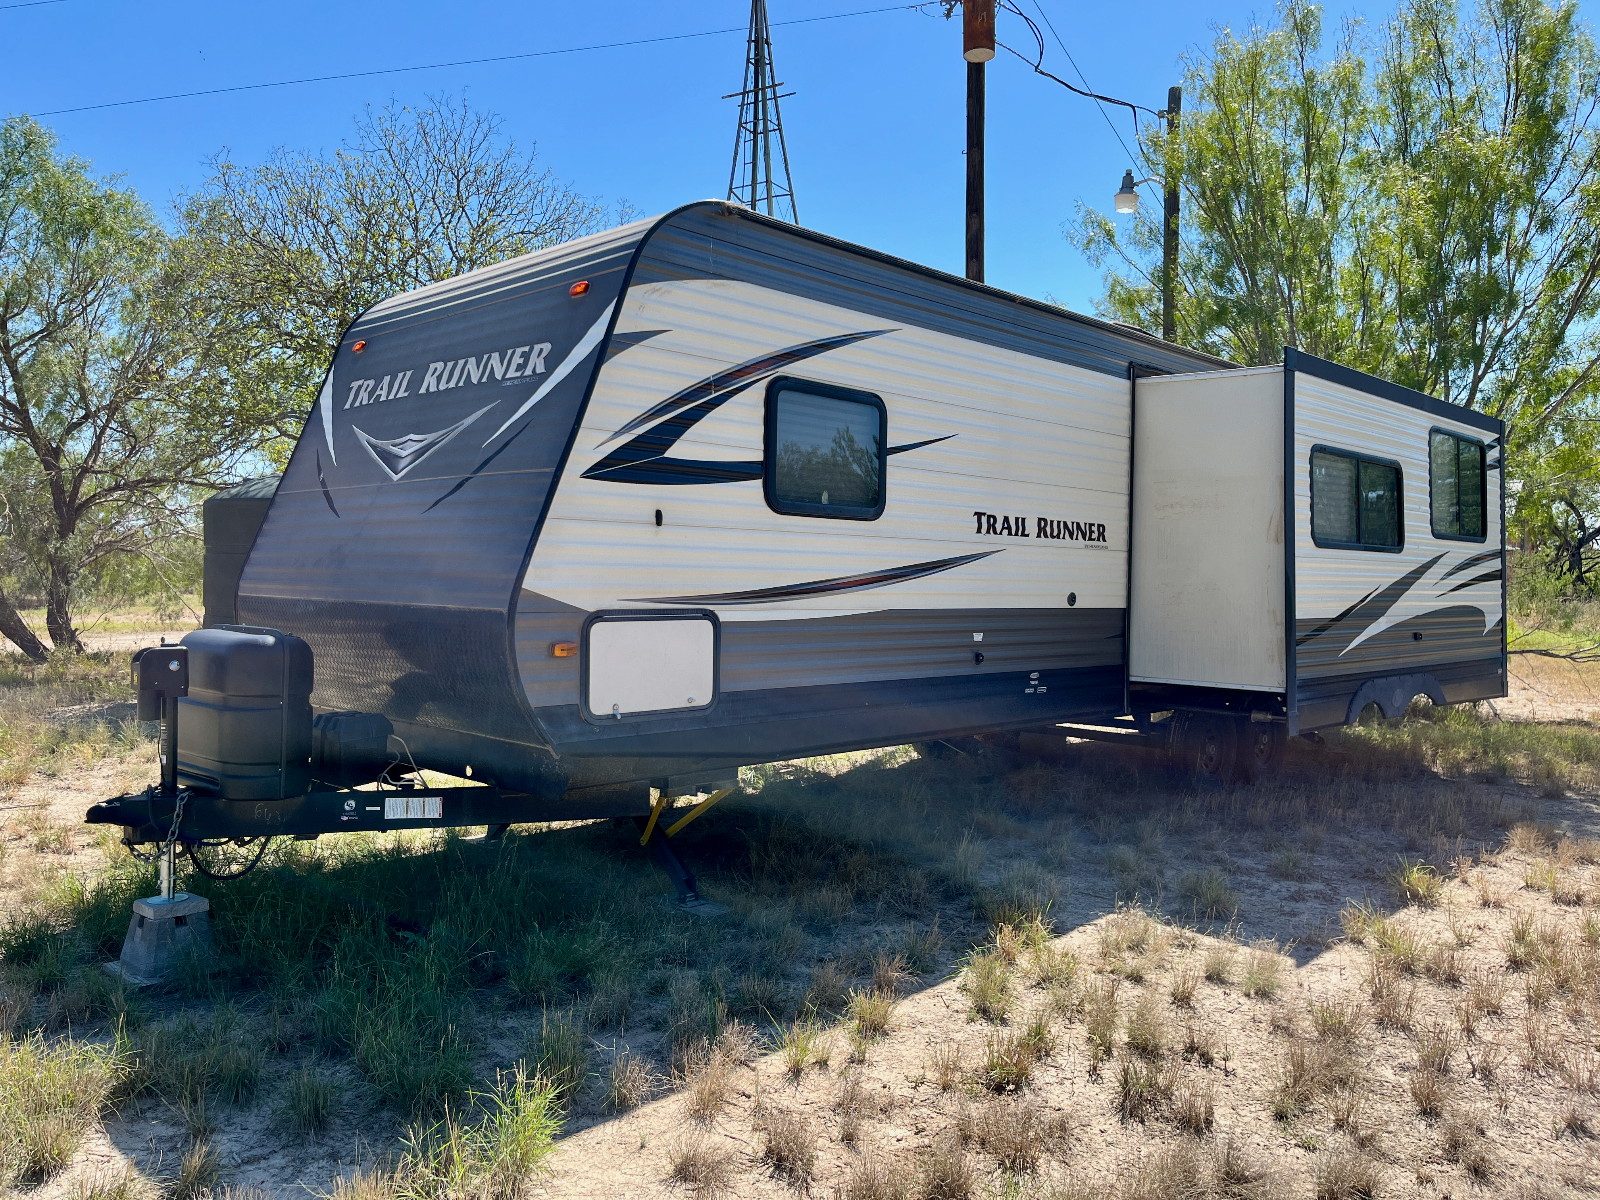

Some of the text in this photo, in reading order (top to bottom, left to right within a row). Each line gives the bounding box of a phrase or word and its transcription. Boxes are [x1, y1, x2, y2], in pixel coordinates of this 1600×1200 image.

[343, 342, 552, 410] TRAIL RUNNER
[973, 511, 1107, 542] TRAIL RUNNER
